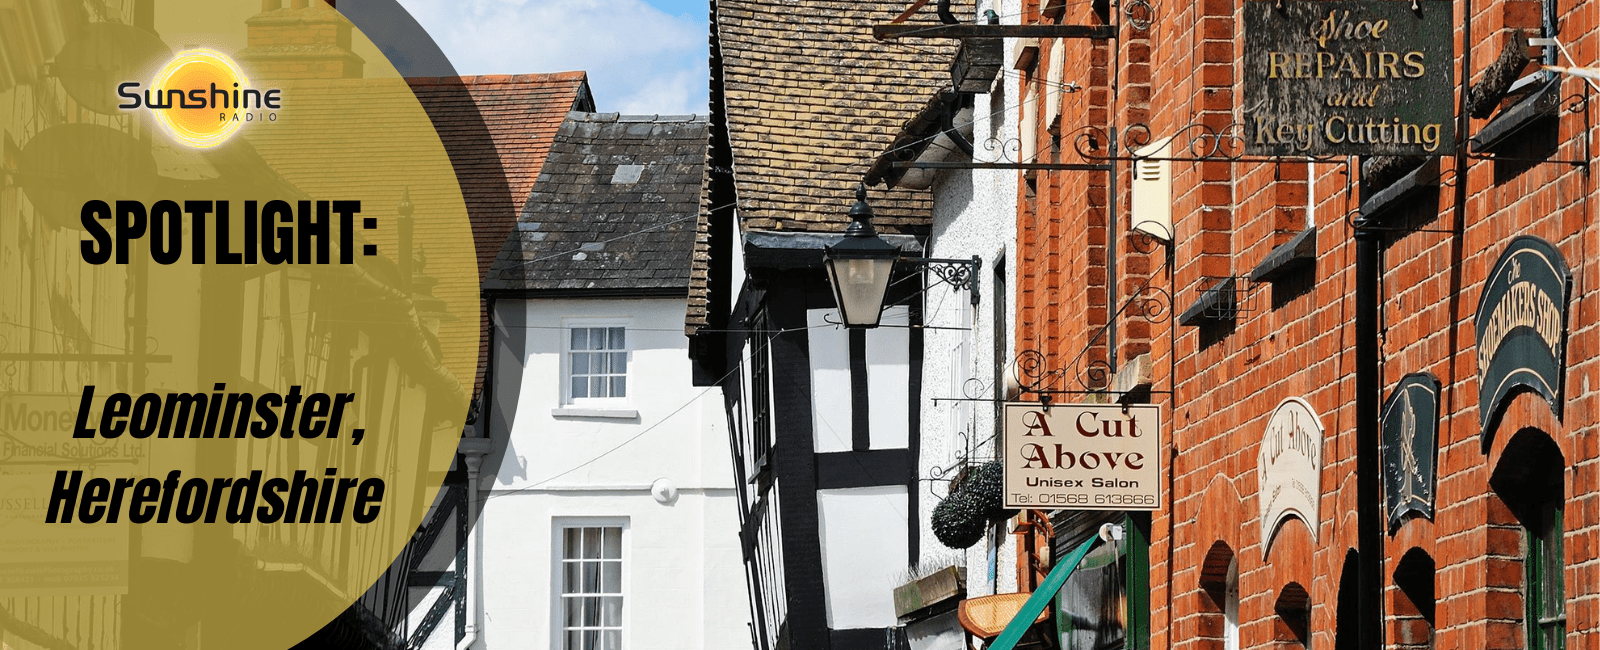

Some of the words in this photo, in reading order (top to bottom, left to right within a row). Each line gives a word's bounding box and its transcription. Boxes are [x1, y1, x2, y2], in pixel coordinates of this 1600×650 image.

[1309, 9, 1389, 49] Shoe
[1268, 51, 1426, 79] REPAIRS
[1326, 84, 1381, 107] and
[1254, 115, 1315, 151] Key
[1325, 115, 1441, 152] Cutting
[1478, 281, 1537, 391] SHOEMAKERS
[1536, 288, 1561, 359] SHOP
[1021, 410, 1056, 437] A
[1075, 411, 1143, 438] Cut
[1020, 442, 1145, 470] Above
[1026, 477, 1084, 488] Unisex
[1091, 477, 1139, 488] Salon
[1011, 493, 1033, 504] Tel:
[1038, 493, 1089, 504] 01568
[1094, 494, 1155, 505] 613666
